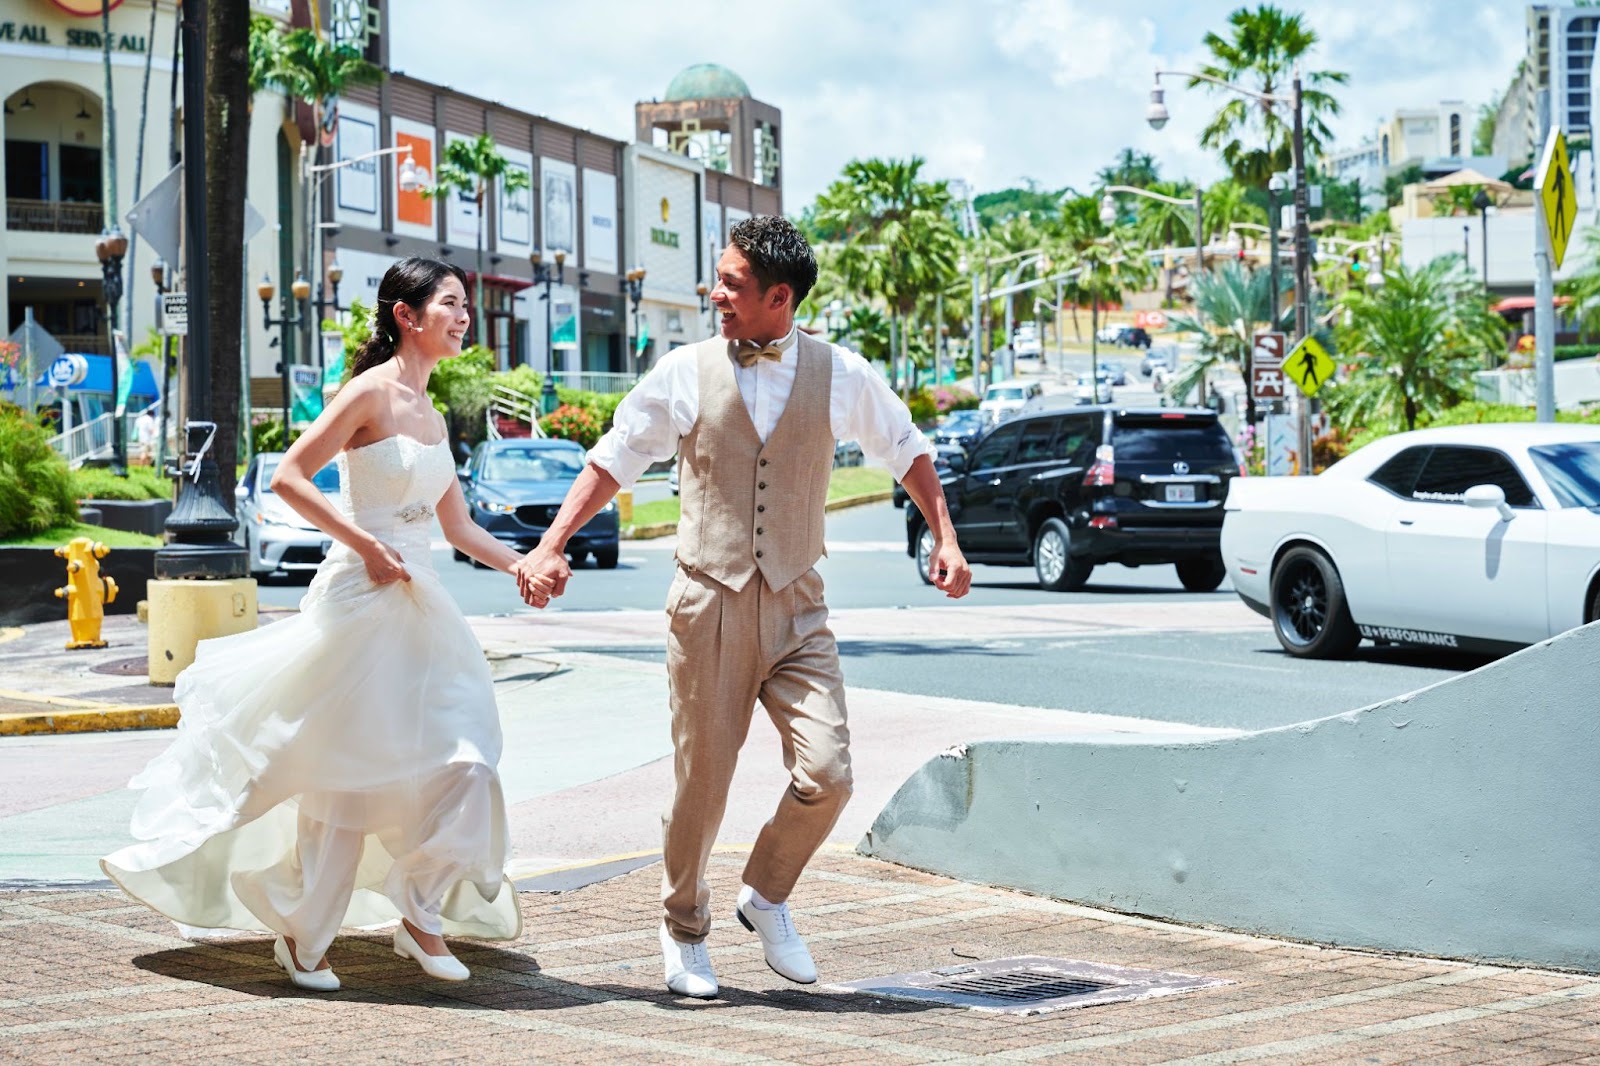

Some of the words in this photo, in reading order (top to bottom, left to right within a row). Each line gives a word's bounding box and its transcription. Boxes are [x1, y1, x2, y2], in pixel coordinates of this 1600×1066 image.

[19, 23, 51, 44] ALL
[118, 34, 146, 52] ALL
[1379, 627, 1459, 647] PERFORMANCE
